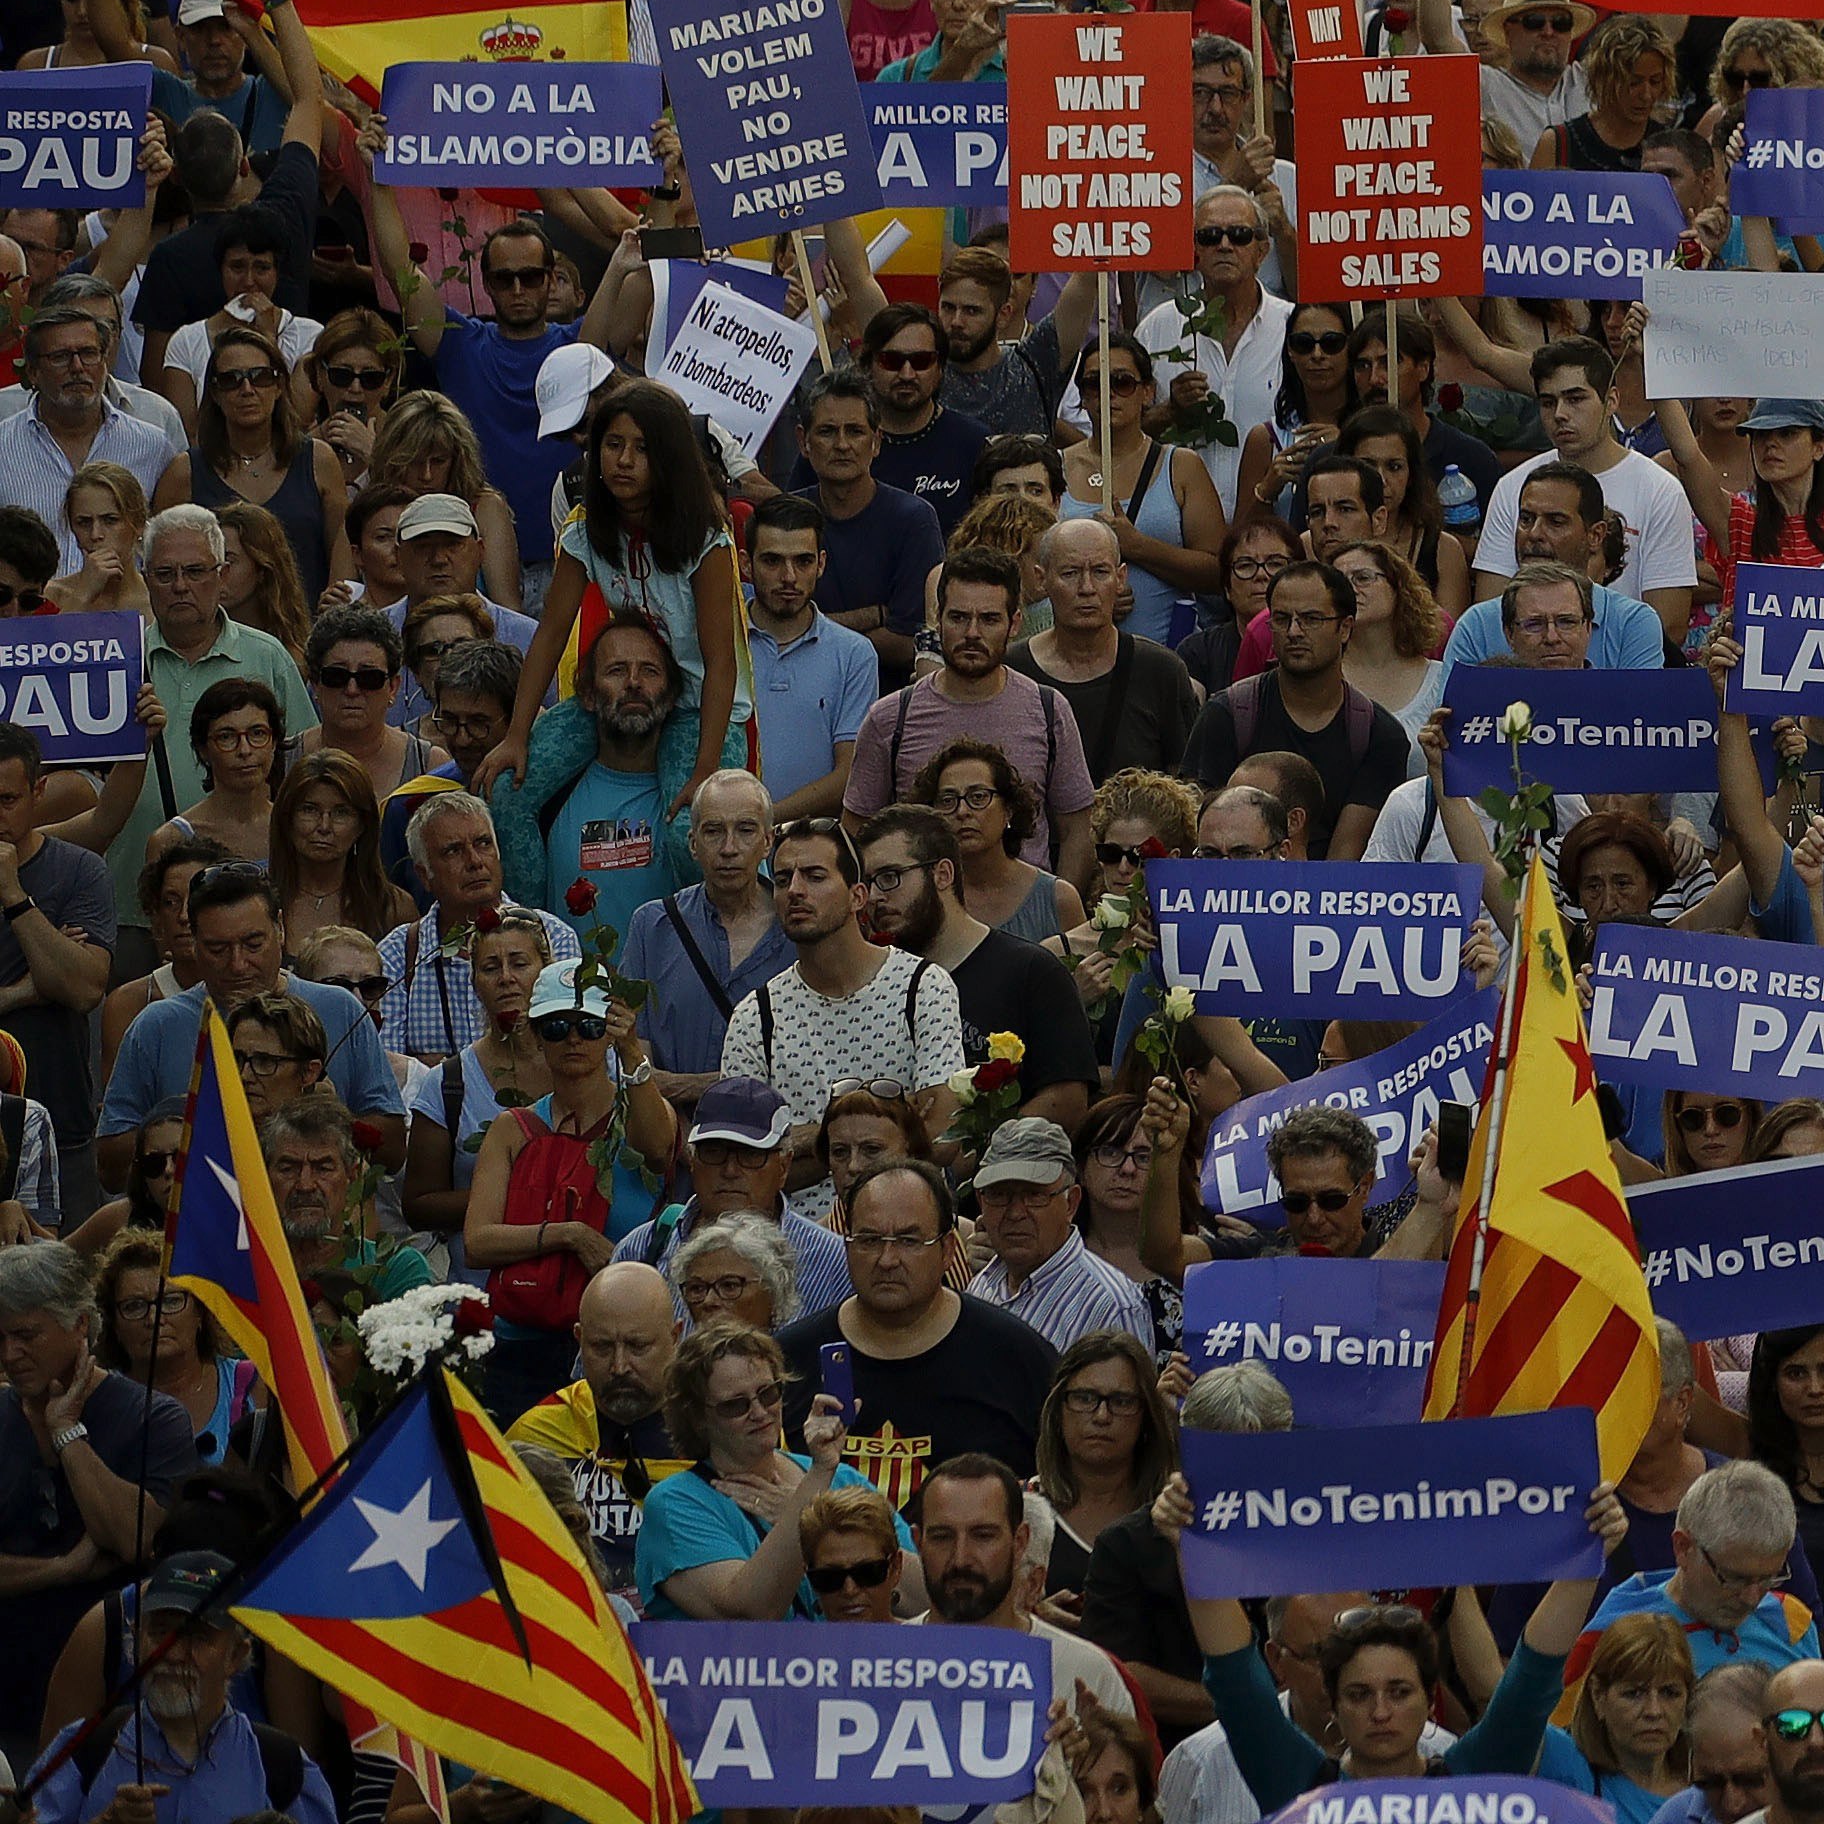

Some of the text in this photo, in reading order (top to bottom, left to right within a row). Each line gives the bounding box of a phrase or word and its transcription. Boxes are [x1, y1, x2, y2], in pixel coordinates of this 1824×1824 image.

[695, 31, 815, 81] VOLEM
[1076, 27, 1123, 64] WE
[726, 73, 803, 112] PAU,
[1054, 75, 1145, 112] WANT
[740, 109, 792, 145] NO
[1046, 124, 1155, 164] PEACE,
[709, 131, 849, 185] VENDRE
[731, 170, 847, 221] ARMES
[1020, 173, 1182, 210] NOT ARMS
[1052, 222, 1152, 258] SALES
[689, 295, 795, 377] Ni atropellos,
[666, 345, 772, 414] ni bombardeos:
[1159, 887, 1463, 918] LA MILLOR RESPOSTA
[1159, 924, 1463, 999] LA PAU
[844, 1436, 930, 1455] USAP
[1202, 1477, 1578, 1533] #NoTenimPor
[1306, 1793, 1549, 1824] MARIANO,
